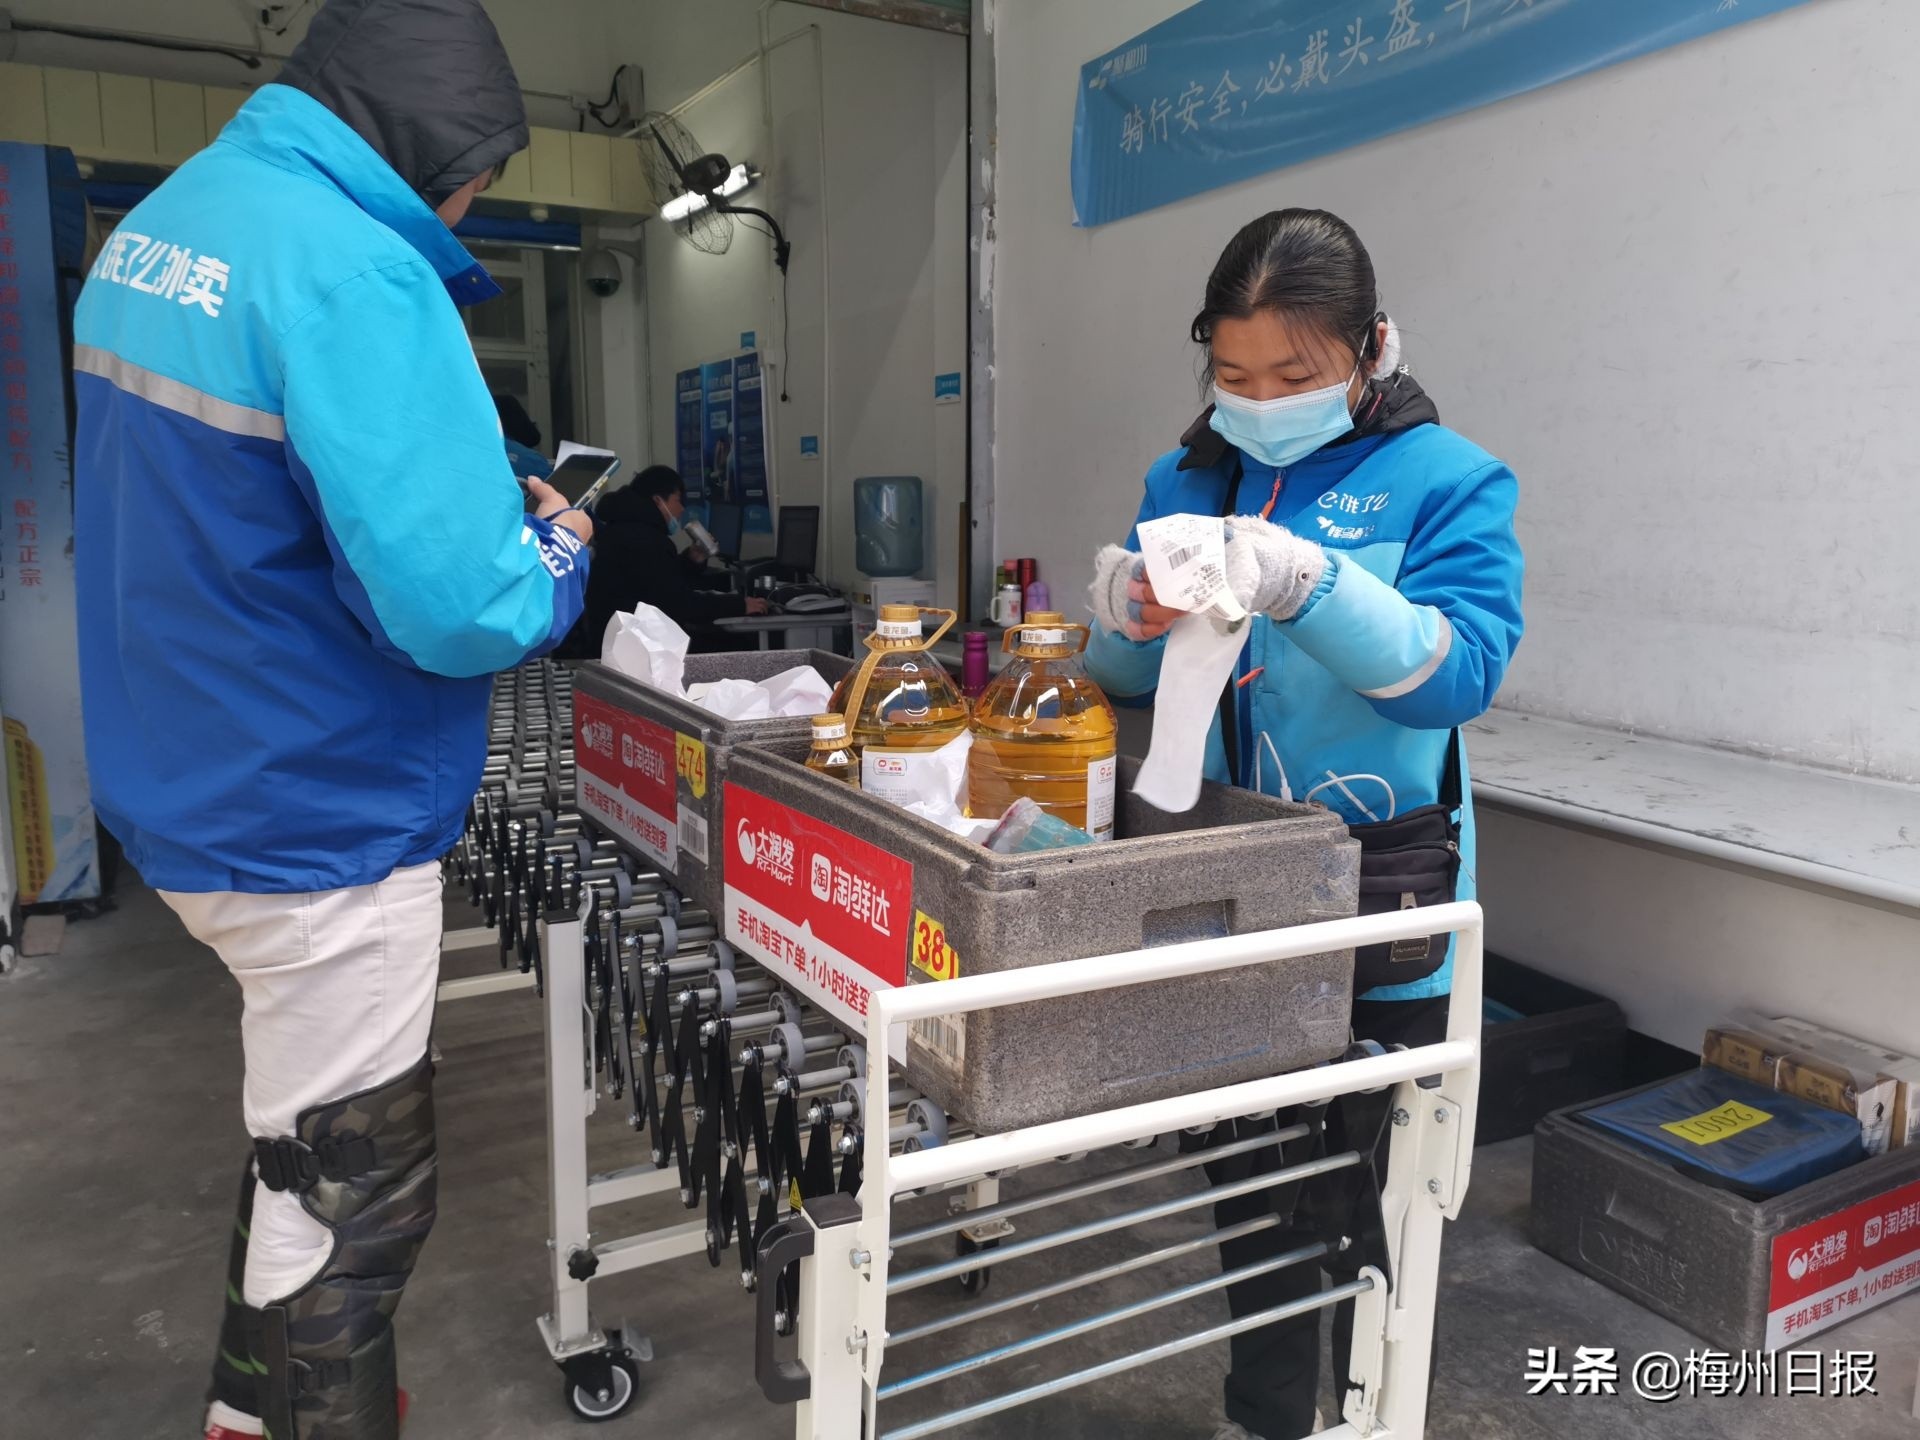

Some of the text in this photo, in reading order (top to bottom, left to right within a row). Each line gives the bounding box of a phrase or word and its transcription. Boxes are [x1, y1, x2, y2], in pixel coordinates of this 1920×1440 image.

[678, 743, 704, 779] 474
[756, 827, 795, 869] 大润发
[756, 858, 794, 886] RT-Mart
[833, 866, 891, 936] 淘鲜达
[1883, 1202, 1920, 1240] 淘鲜
[1808, 1252, 1847, 1275] RT-Mart
[1809, 1230, 1848, 1263] 大润发
